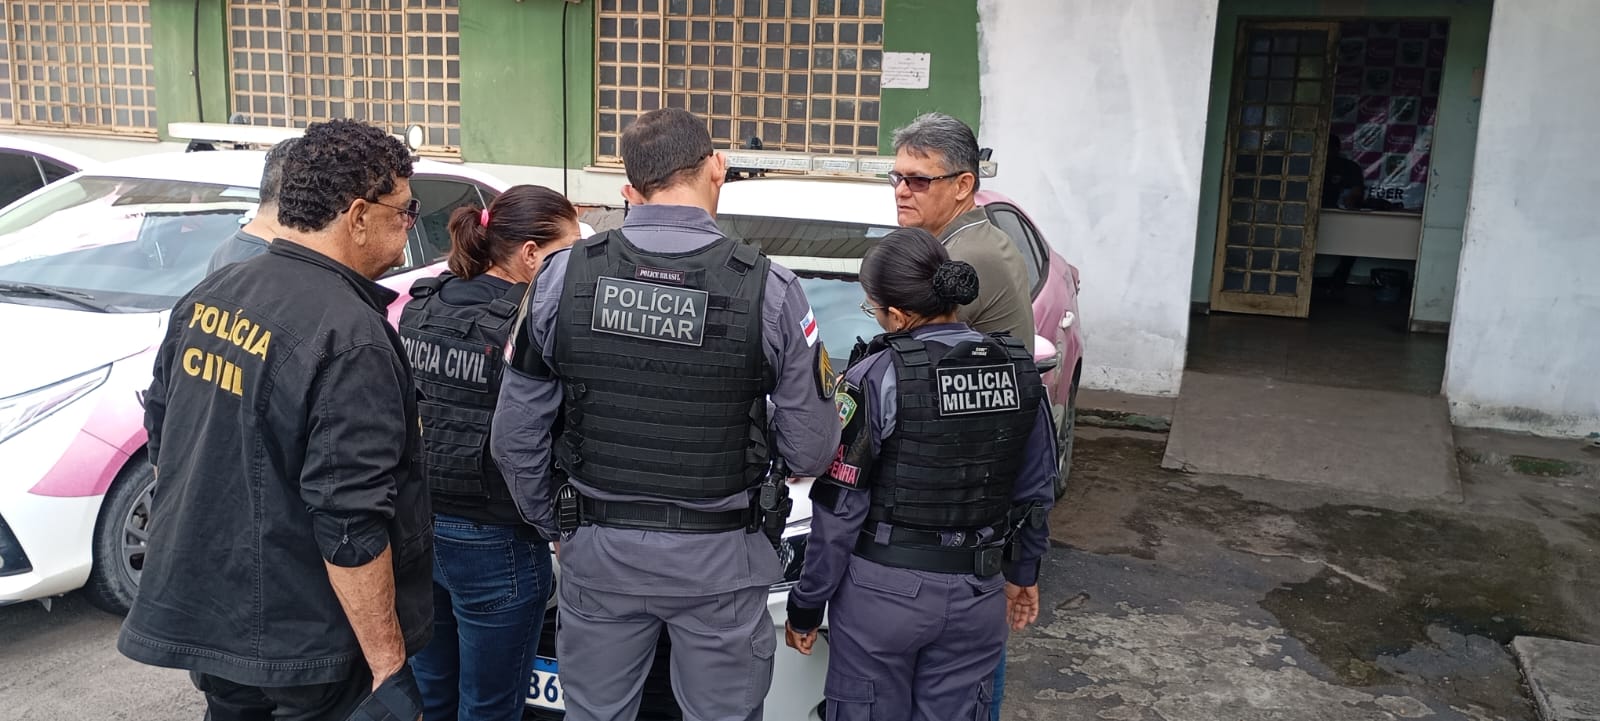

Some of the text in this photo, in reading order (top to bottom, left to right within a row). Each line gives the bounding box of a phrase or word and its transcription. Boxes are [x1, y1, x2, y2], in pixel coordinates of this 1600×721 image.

[660, 272, 681, 281] BRASIL
[603, 285, 696, 317] POLÍCIA
[188, 302, 271, 361] POLÍCIA
[601, 308, 693, 340] MILITAR
[183, 347, 243, 397] CIVIL
[445, 347, 487, 384] CIVIL
[941, 369, 1013, 393] POLÍCIA
[943, 389, 1016, 411] MILITAR
[826, 461, 856, 485] ENHA
